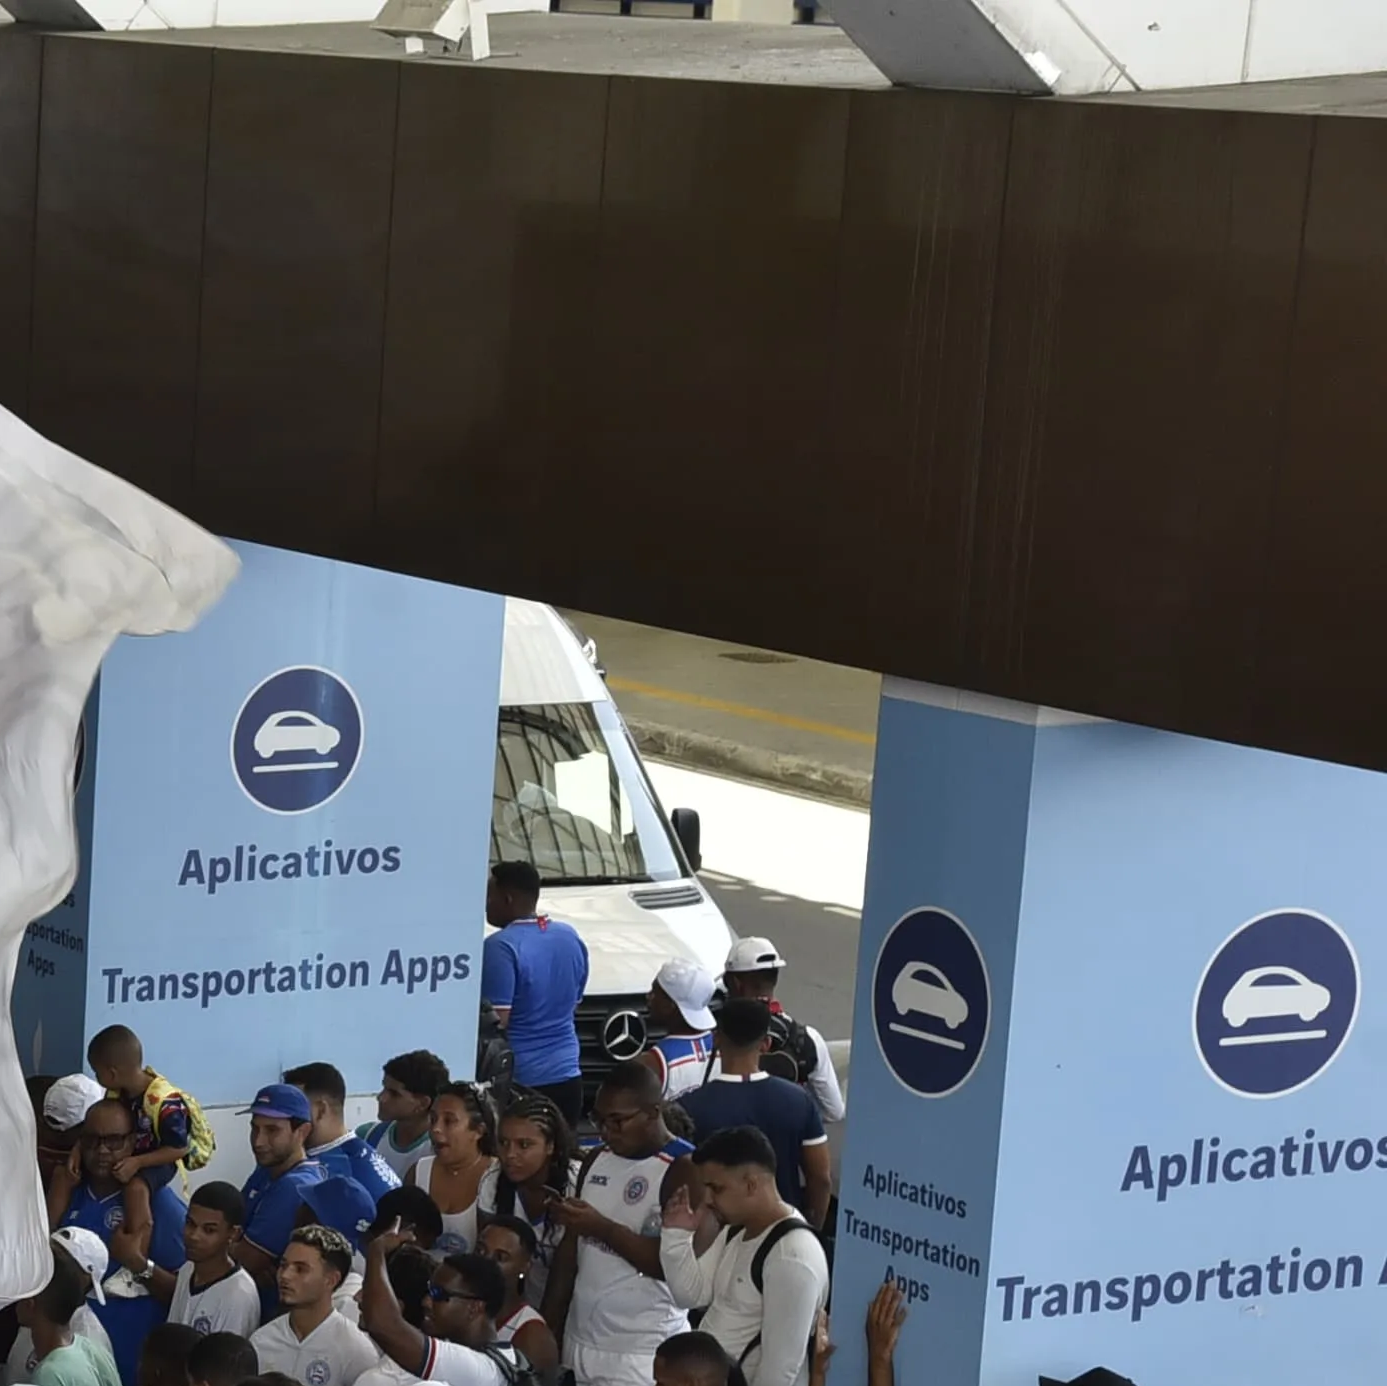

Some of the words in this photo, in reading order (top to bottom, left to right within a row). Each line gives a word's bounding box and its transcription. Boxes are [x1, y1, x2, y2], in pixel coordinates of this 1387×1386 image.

[178, 839, 402, 895] Aplicativos
[27, 957, 56, 978] Apps
[101, 951, 371, 1009] Transportation
[380, 948, 471, 994] Apps
[862, 1163, 968, 1221] Aplicativos
[842, 1207, 981, 1279] Transportation
[883, 1264, 930, 1304] Apps
[995, 1247, 1365, 1323] Transportation
